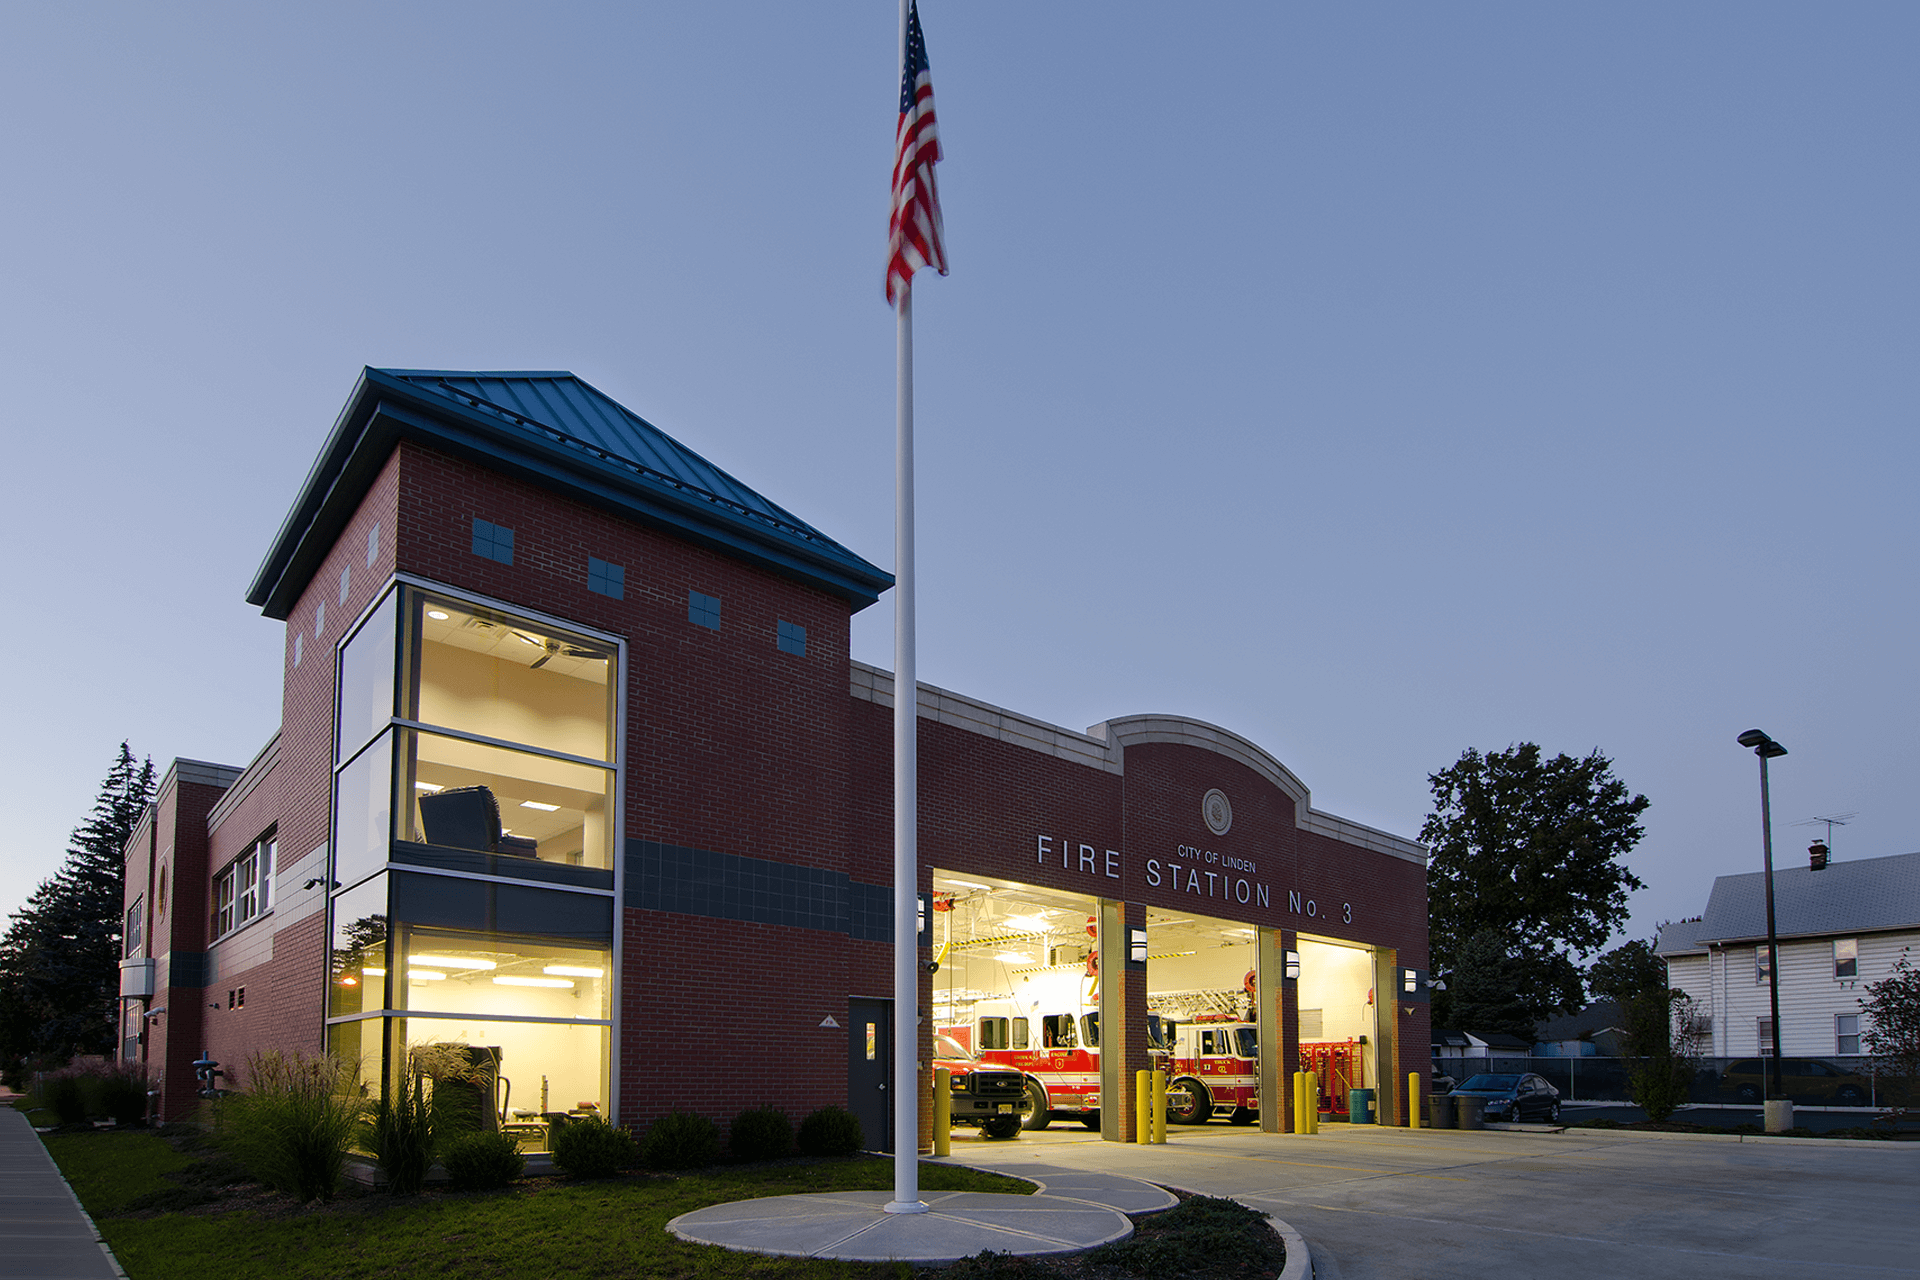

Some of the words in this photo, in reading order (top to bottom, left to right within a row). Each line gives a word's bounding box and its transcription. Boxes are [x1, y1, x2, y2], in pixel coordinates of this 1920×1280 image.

[1038, 834, 1120, 879] FIRE
[1146, 859, 1269, 908] STATION
[1289, 890, 1326, 918] No.
[1342, 902, 1352, 924] 3
[1178, 844, 1201, 860] CITY
[1205, 851, 1219, 864] OF
[1222, 855, 1256, 873] LINDEN
